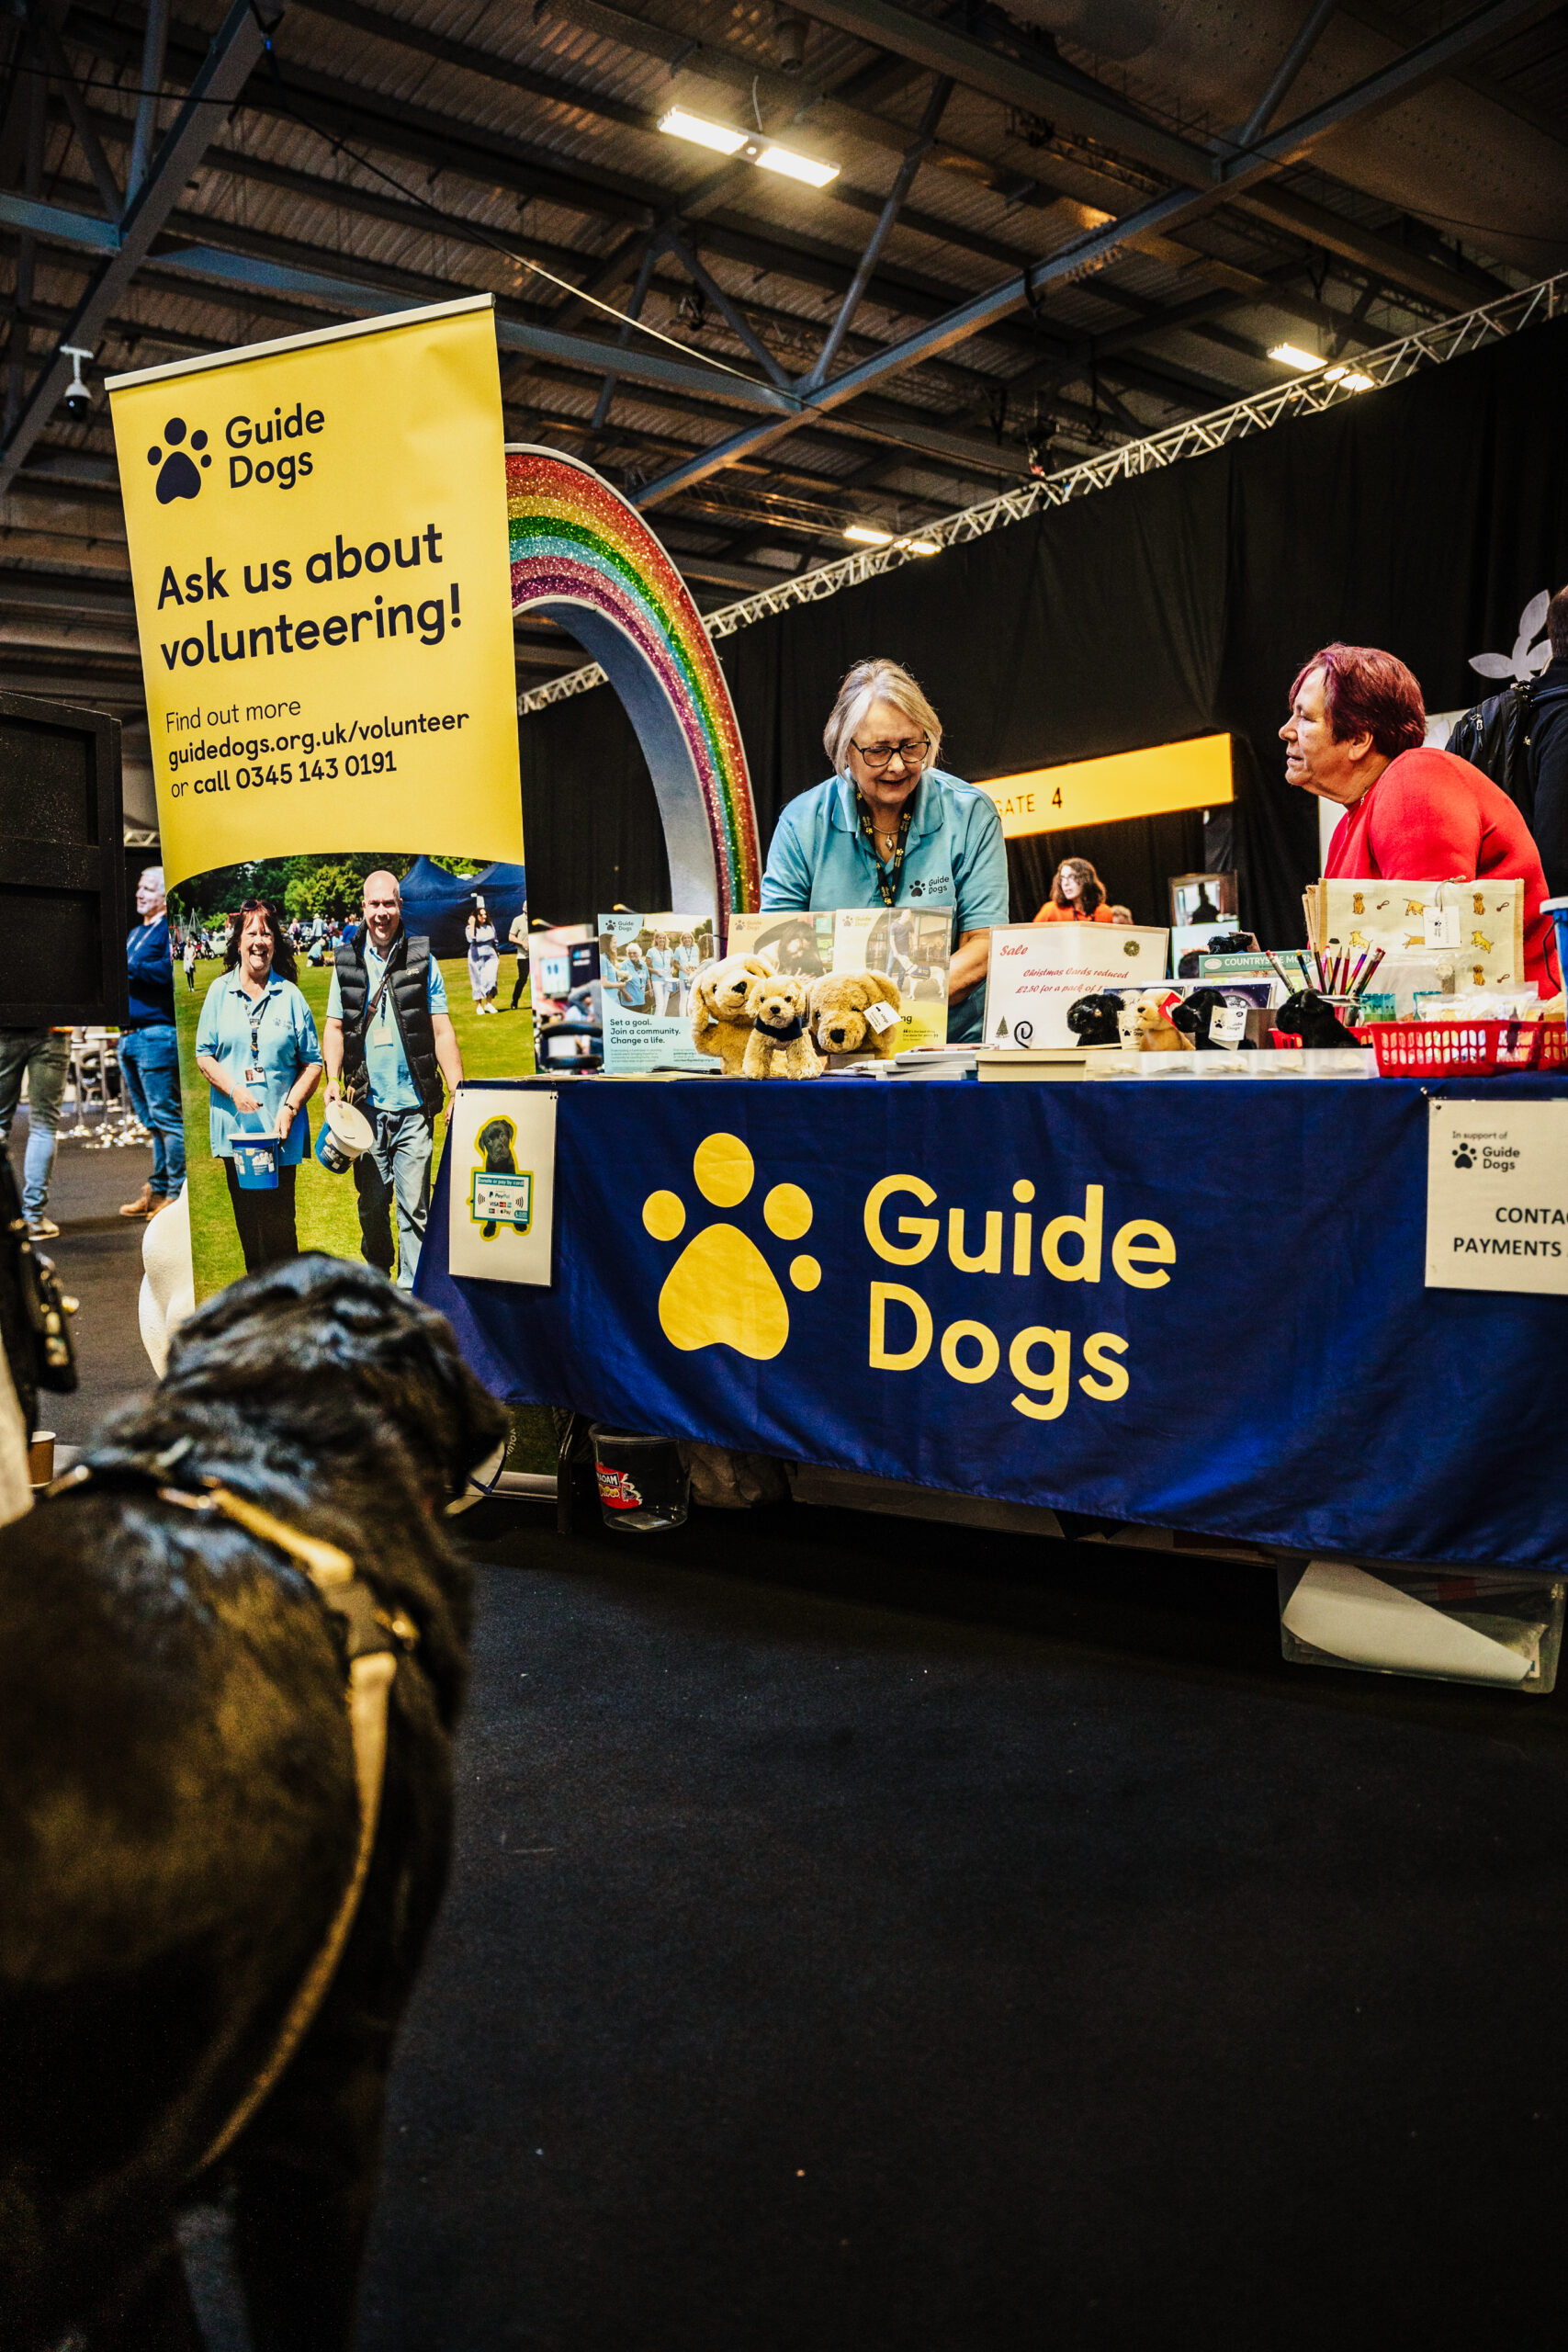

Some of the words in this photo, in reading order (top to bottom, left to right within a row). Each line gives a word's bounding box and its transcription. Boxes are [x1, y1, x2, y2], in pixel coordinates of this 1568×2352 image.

[225, 402, 325, 449] Guide
[229, 451, 314, 491] Dogs
[157, 556, 230, 610] Ask
[243, 558, 292, 594] us
[306, 523, 443, 584] about
[160, 582, 462, 672] volunteering!
[166, 706, 201, 733] Find
[207, 702, 240, 727] out
[245, 698, 301, 723] more
[168, 711, 470, 771] guidedogs.org.uk/volunteer
[171, 779, 189, 797] or
[193, 769, 231, 795] call
[235, 762, 293, 790] 0345
[299, 757, 339, 783] 143
[344, 750, 398, 778] 0191
[1052, 786, 1063, 808] 4
[929, 875, 950, 887] Guide
[928, 885, 948, 895] Dogs
[999, 944, 1029, 956] Sale
[1224, 956, 1284, 967] COUNTRYSE
[1022, 967, 1064, 978] Christmas
[1066, 967, 1092, 977] Cards
[1093, 968, 1129, 979] reduced
[1040, 984, 1053, 994] for
[1062, 983, 1083, 993] pack
[1085, 984, 1095, 994] of
[610, 1018, 623, 1026] Set
[632, 1018, 652, 1027] goal.
[610, 1027, 627, 1035] Join
[636, 1027, 681, 1036] community.
[610, 1036, 642, 1046] Change
[650, 1036, 665, 1045] life.
[1463, 1131, 1497, 1141] support
[1498, 1131, 1508, 1139] of
[1483, 1146, 1520, 1158] Guide
[1483, 1158, 1516, 1173] Dogs
[1495, 1206, 1568, 1225] CONTA
[863, 1173, 1177, 1290] Guide
[1453, 1237, 1562, 1258] PAYMENTS
[869, 1281, 1130, 1421] Dogs
